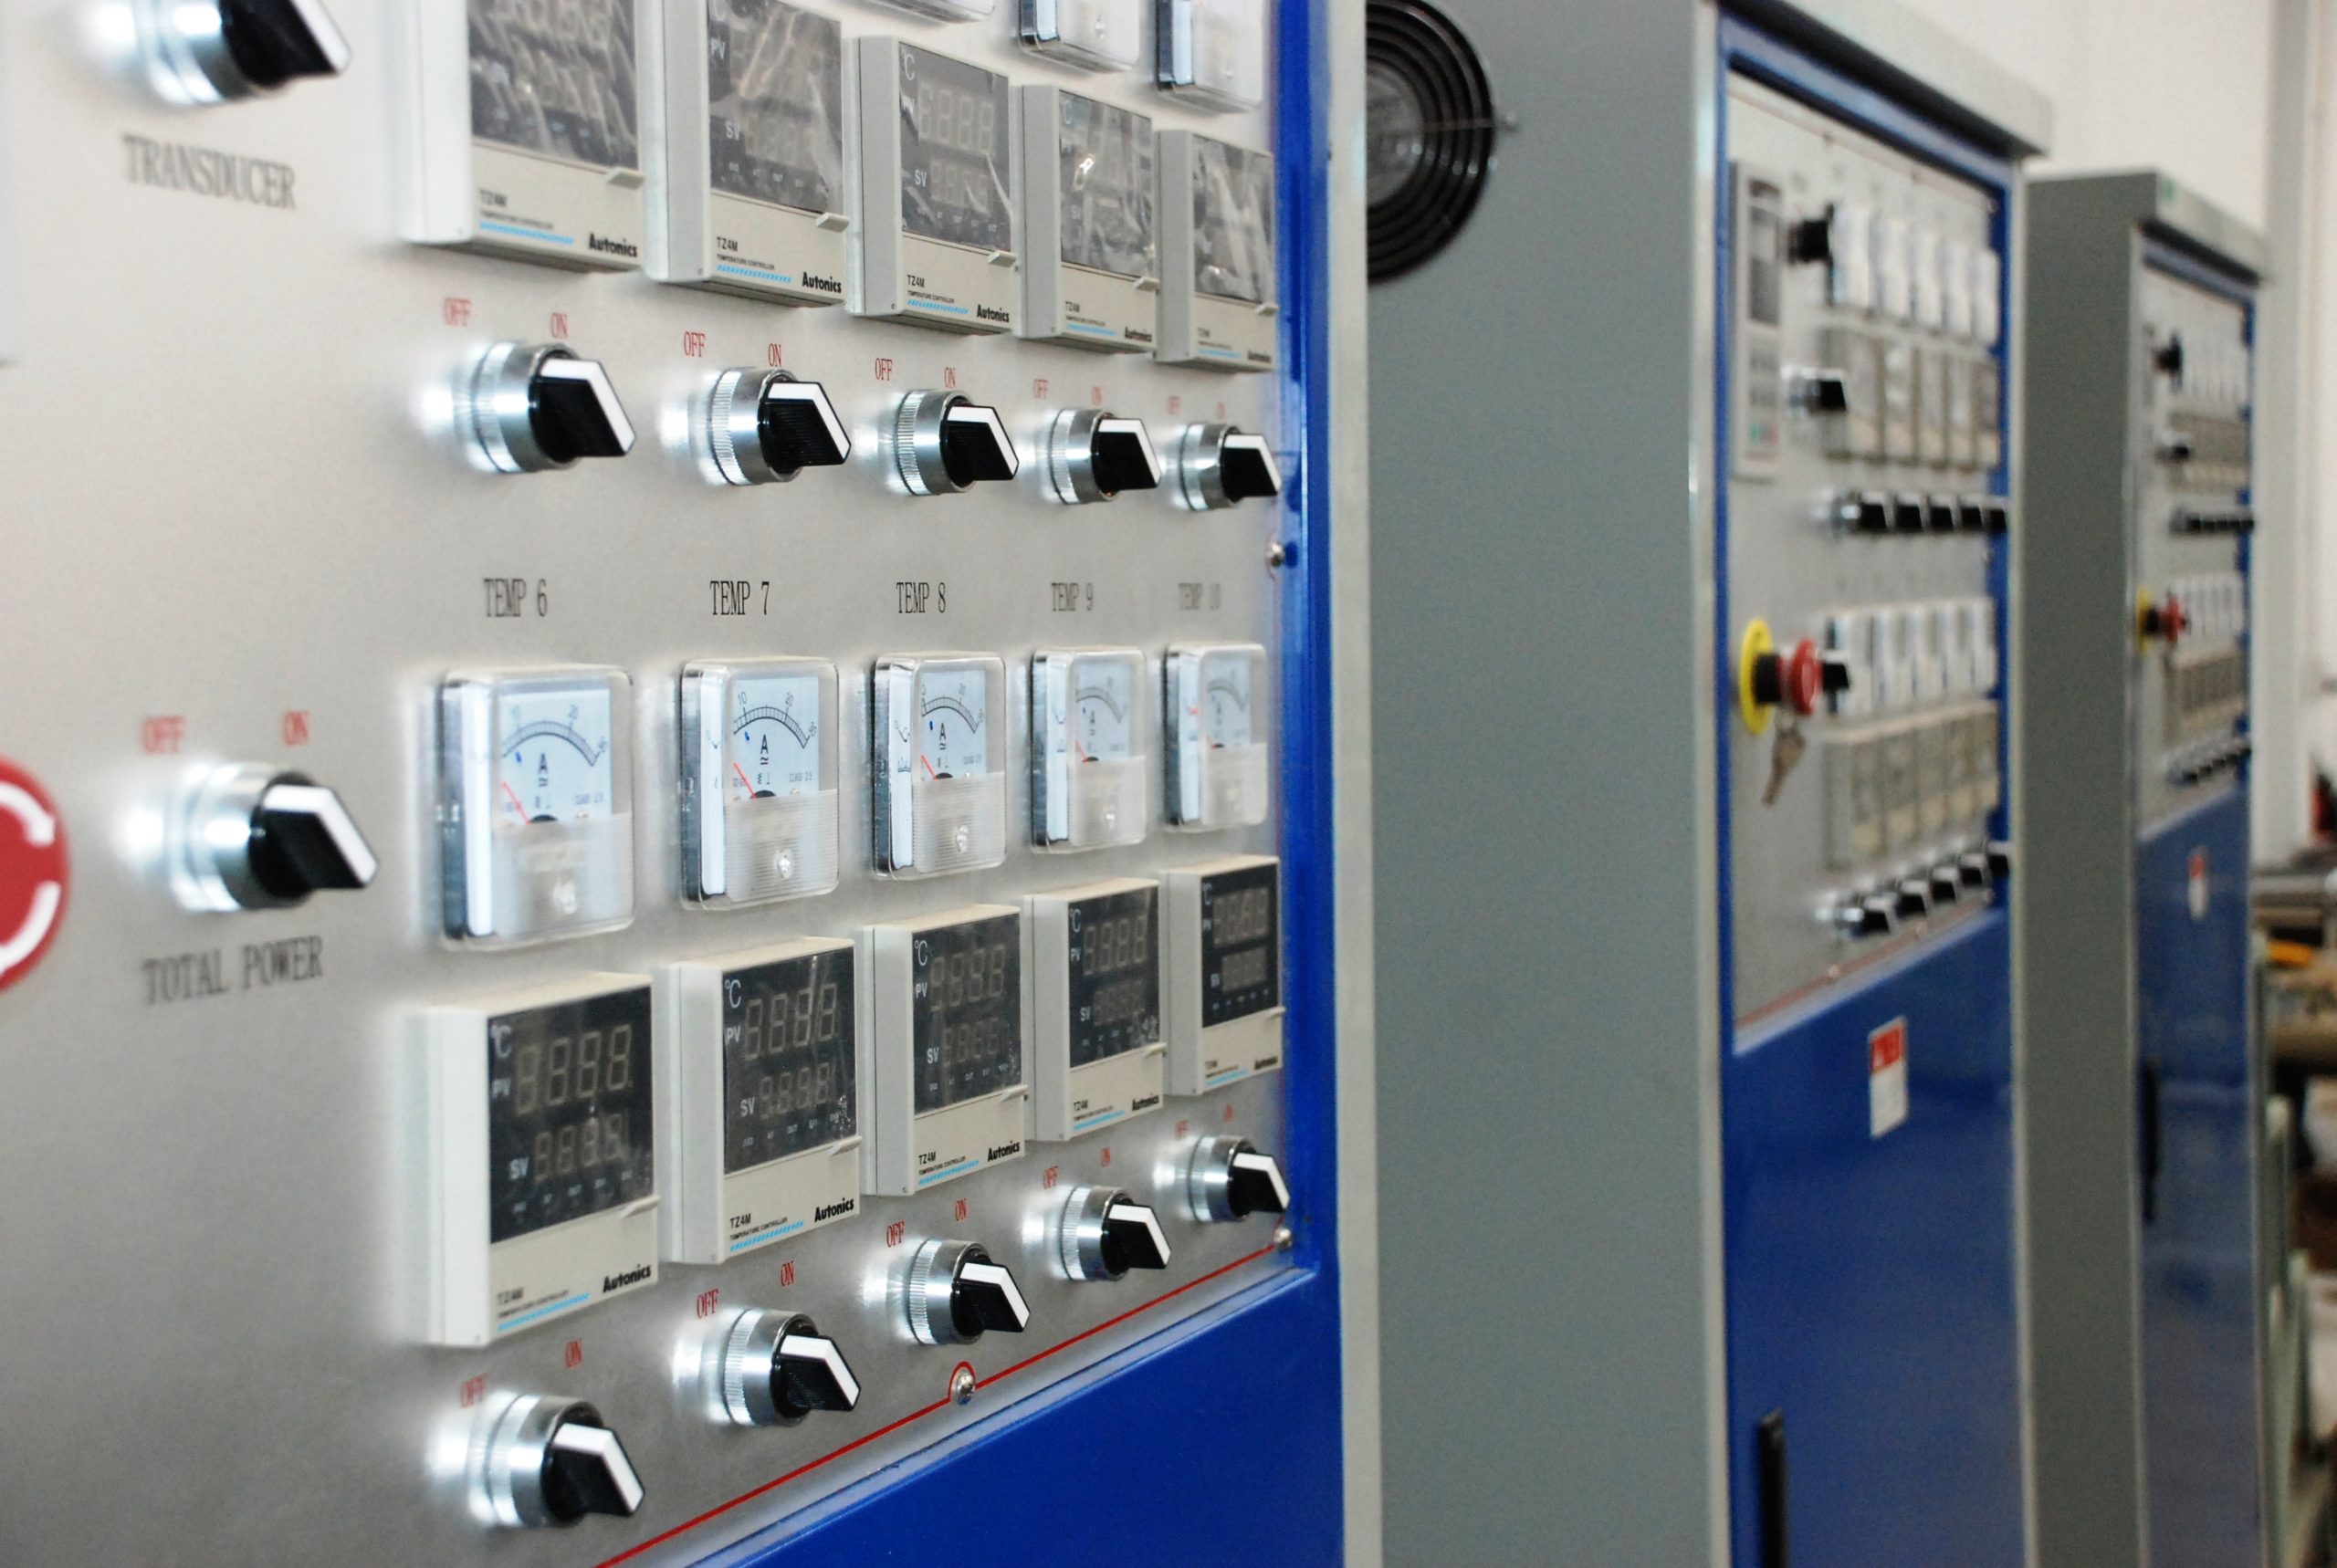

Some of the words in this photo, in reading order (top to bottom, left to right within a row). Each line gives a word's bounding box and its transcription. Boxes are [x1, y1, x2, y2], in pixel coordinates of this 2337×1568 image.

[121, 133, 296, 210] TRANSDUCER
[915, 169, 927, 187] SV
[589, 233, 637, 257] Autonics
[717, 236, 738, 252] TZ4M
[802, 272, 842, 293] Autonics
[907, 274, 925, 288] TZ4M
[443, 298, 472, 327] OFF
[977, 304, 1010, 323] Autonics
[550, 312, 568, 339] ON
[684, 331, 706, 358] OFF
[768, 343, 782, 367] ON
[875, 358, 893, 381] OFF
[945, 367, 957, 388] ON
[483, 578, 527, 617] TEMP
[537, 578, 548, 617] 6
[709, 580, 750, 616] TEMP
[761, 581, 770, 616] 7
[896, 582, 929, 613] TEMP
[938, 582, 946, 613] 8
[1051, 582, 1079, 612] TEMP
[1086, 583, 1094, 612] 9
[738, 691, 747, 706] 10
[141, 716, 185, 755] OFF
[283, 710, 309, 746] ON
[939, 722, 947, 741] A
[760, 734, 769, 754] A
[539, 752, 548, 774] A
[142, 947, 230, 1005] TOTAL
[242, 936, 323, 988] POWER
[916, 983, 927, 998] PV
[726, 1026, 741, 1044] PV
[927, 1048, 939, 1064] SV
[740, 1097, 755, 1117] SV
[918, 1151, 936, 1166] TZ4M
[988, 1140, 1021, 1162] Autonics
[730, 1213, 751, 1228] TZ4M
[814, 1197, 854, 1222] Autonics
[955, 1197, 968, 1221] ON
[886, 1221, 905, 1248] OFF
[603, 1264, 651, 1293] Autonics
[781, 1260, 795, 1287] ON
[697, 1289, 718, 1319] OFF
[565, 1339, 582, 1368] ON
[460, 1373, 487, 1408] OFF
